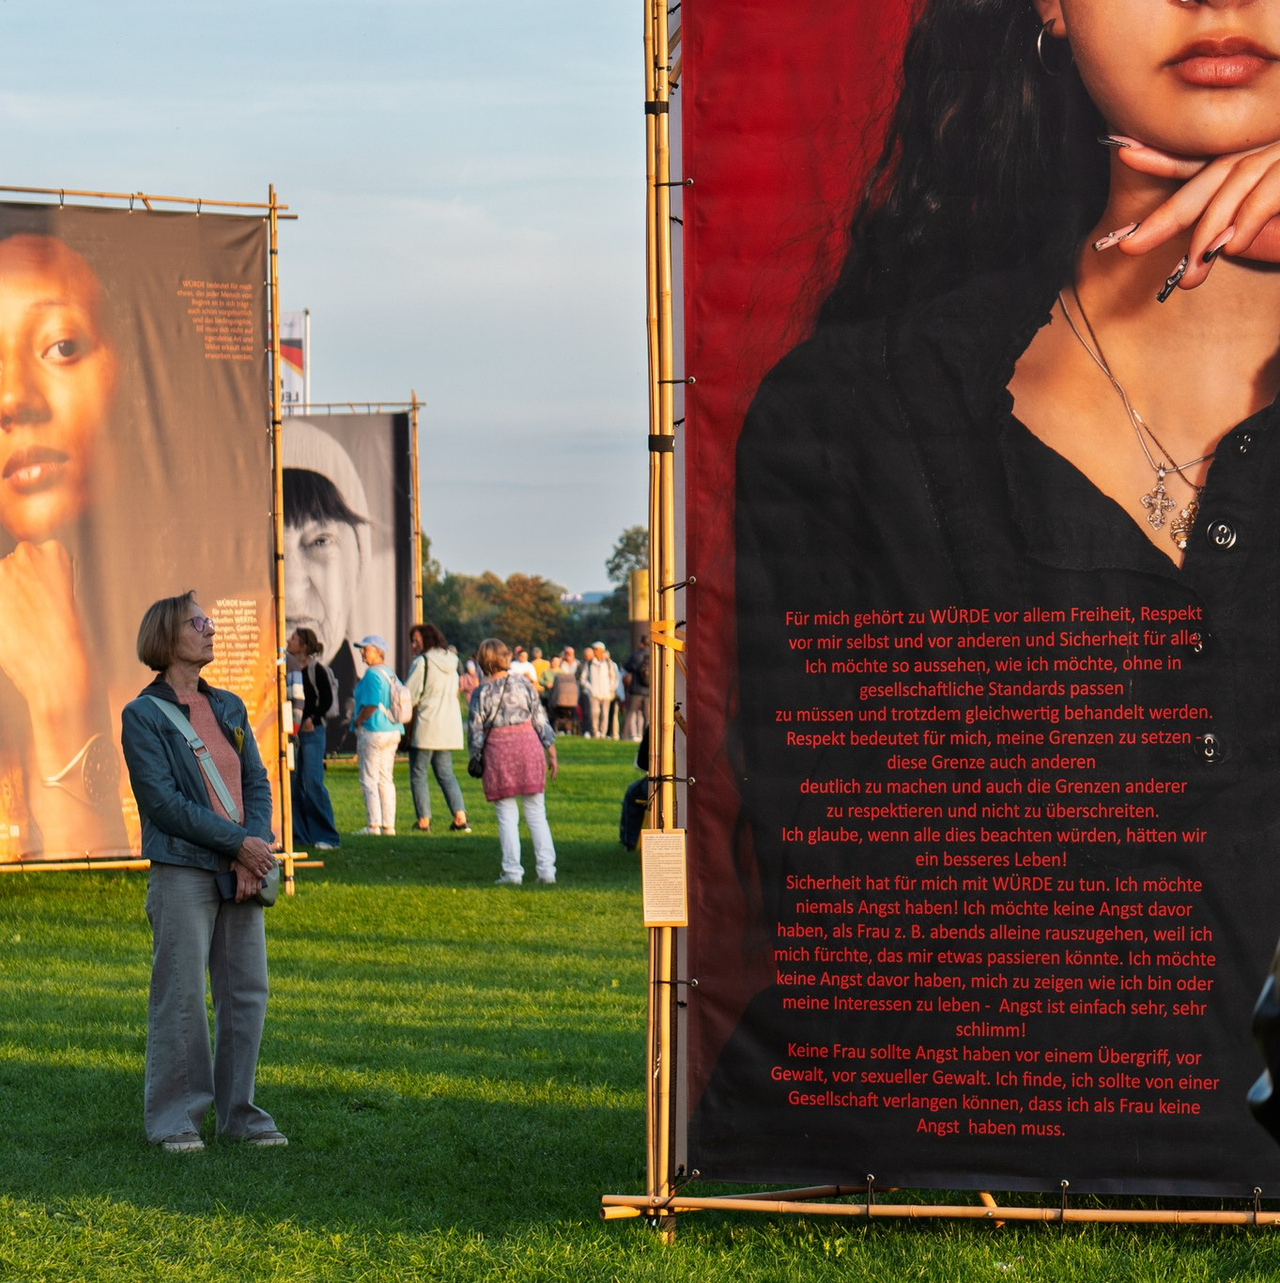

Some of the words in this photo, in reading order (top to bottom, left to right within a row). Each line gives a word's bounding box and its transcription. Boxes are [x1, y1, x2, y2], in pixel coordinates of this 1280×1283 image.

[785, 610, 810, 626] Für
[813, 610, 850, 626] mich
[853, 610, 904, 629] gehört
[908, 612, 926, 625] zu
[929, 605, 990, 624] WÜRDE
[993, 610, 1019, 624] vor
[1022, 607, 1066, 623] allem
[1070, 606, 1136, 624] Freiheit,
[1140, 604, 1203, 624] Respekt
[788, 638, 813, 651] vor
[816, 634, 842, 650] mir
[846, 633, 890, 650] selbst
[893, 632, 924, 649] und
[927, 636, 953, 649] vor
[956, 632, 1021, 649] anderen
[1025, 631, 1055, 648] und
[1059, 630, 1139, 647] Sicherheit
[1143, 629, 1167, 646] für
[805, 658, 828, 675] Ich
[831, 658, 888, 674] möchte
[891, 661, 910, 673] so
[913, 656, 991, 674] aussehen,
[994, 659, 1023, 673] wie
[1026, 656, 1049, 672] ich
[1053, 655, 1118, 673] möchte,
[1122, 654, 1164, 671] ohne
[1167, 655, 1182, 671] in
[859, 680, 985, 701] gesellschaftliche
[988, 680, 1066, 697] Standards
[1069, 683, 1124, 699] passen
[955, 1021, 1026, 1037] schlimm!
[770, 1065, 828, 1084] Gewalt,
[831, 1070, 857, 1083] vor
[860, 1068, 929, 1085] sexueller
[932, 1069, 991, 1086] Gewalt.
[995, 1071, 1019, 1087] Ich
[1022, 1070, 1067, 1090] finde,
[1071, 1072, 1094, 1088] ich
[1098, 1072, 1142, 1090] sollte
[1144, 1077, 1174, 1090] von
[1178, 1074, 1221, 1091] einer
[916, 1118, 960, 1137] Angst
[968, 1118, 1017, 1135] haben
[1020, 1123, 1066, 1137] muss.
